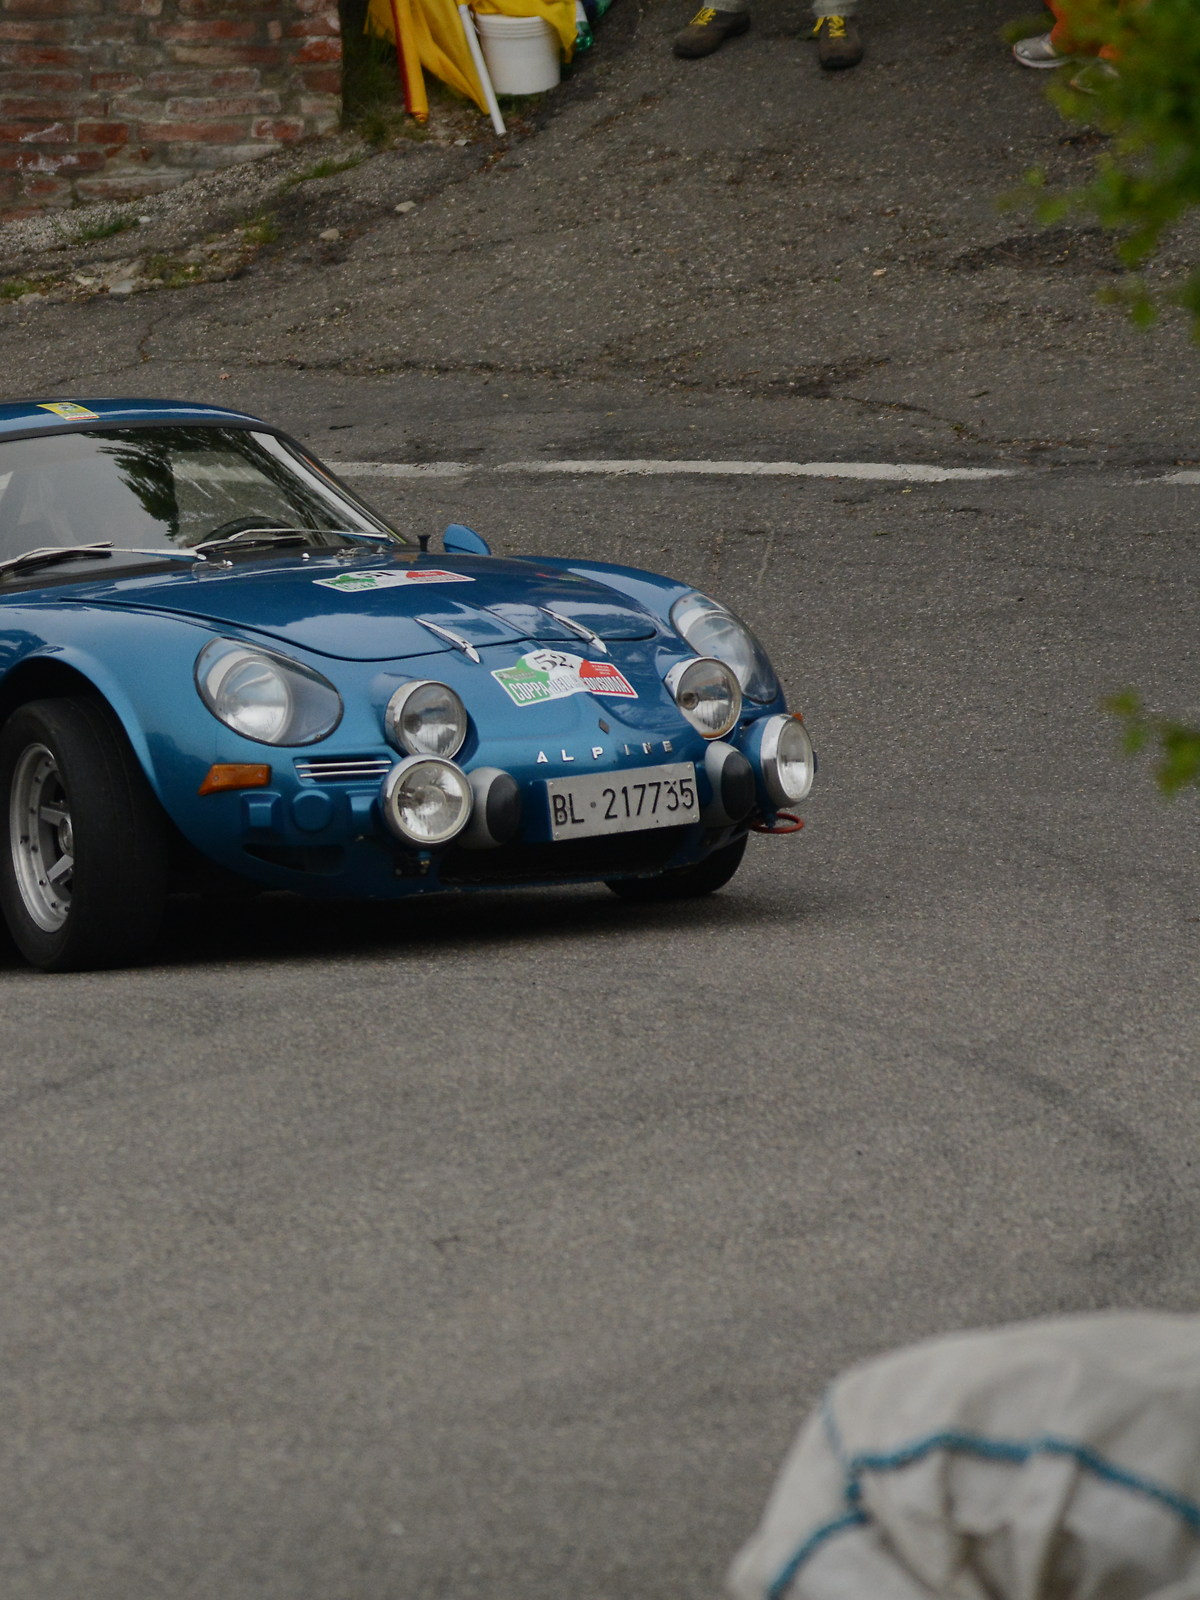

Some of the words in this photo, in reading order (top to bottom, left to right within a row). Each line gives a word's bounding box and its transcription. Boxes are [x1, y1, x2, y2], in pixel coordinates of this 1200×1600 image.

[533, 653, 575, 672] 52
[508, 680, 551, 702] COPPA
[536, 740, 673, 764] ALPINE
[552, 792, 585, 826] BL
[602, 778, 695, 820] 217735
